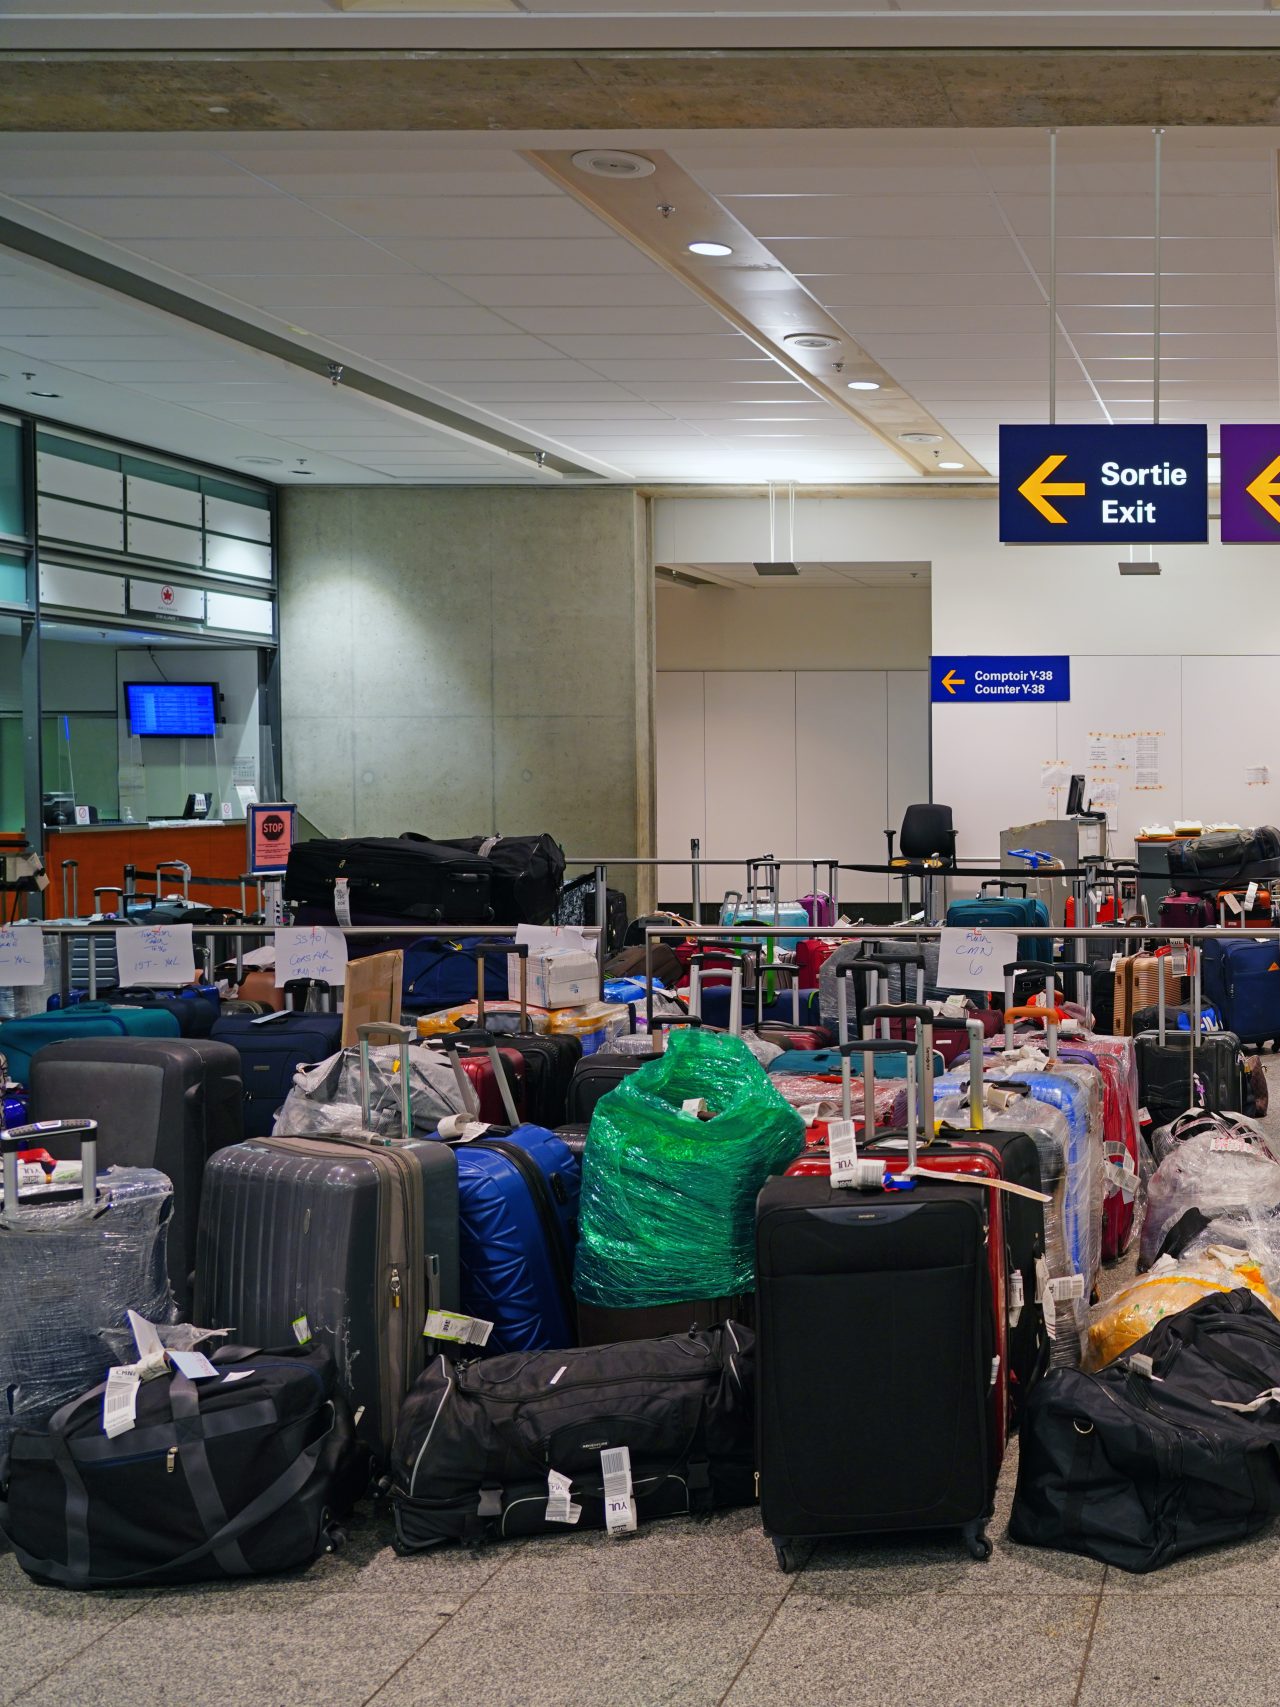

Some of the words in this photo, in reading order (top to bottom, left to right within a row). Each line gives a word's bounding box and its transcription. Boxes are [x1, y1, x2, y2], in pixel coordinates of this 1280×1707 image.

[1101, 461, 1187, 486] Sortie
[1102, 499, 1156, 524] Exit
[974, 670, 1029, 683] Comptoir
[1029, 670, 1053, 681] Y-38
[974, 684, 1020, 694] Counter
[1021, 684, 1045, 694] Y-38
[263, 823, 284, 833] STOP
[968, 958, 983, 976] 6
[836, 1159, 854, 1169] YUL
[608, 1501, 628, 1512] YUL
